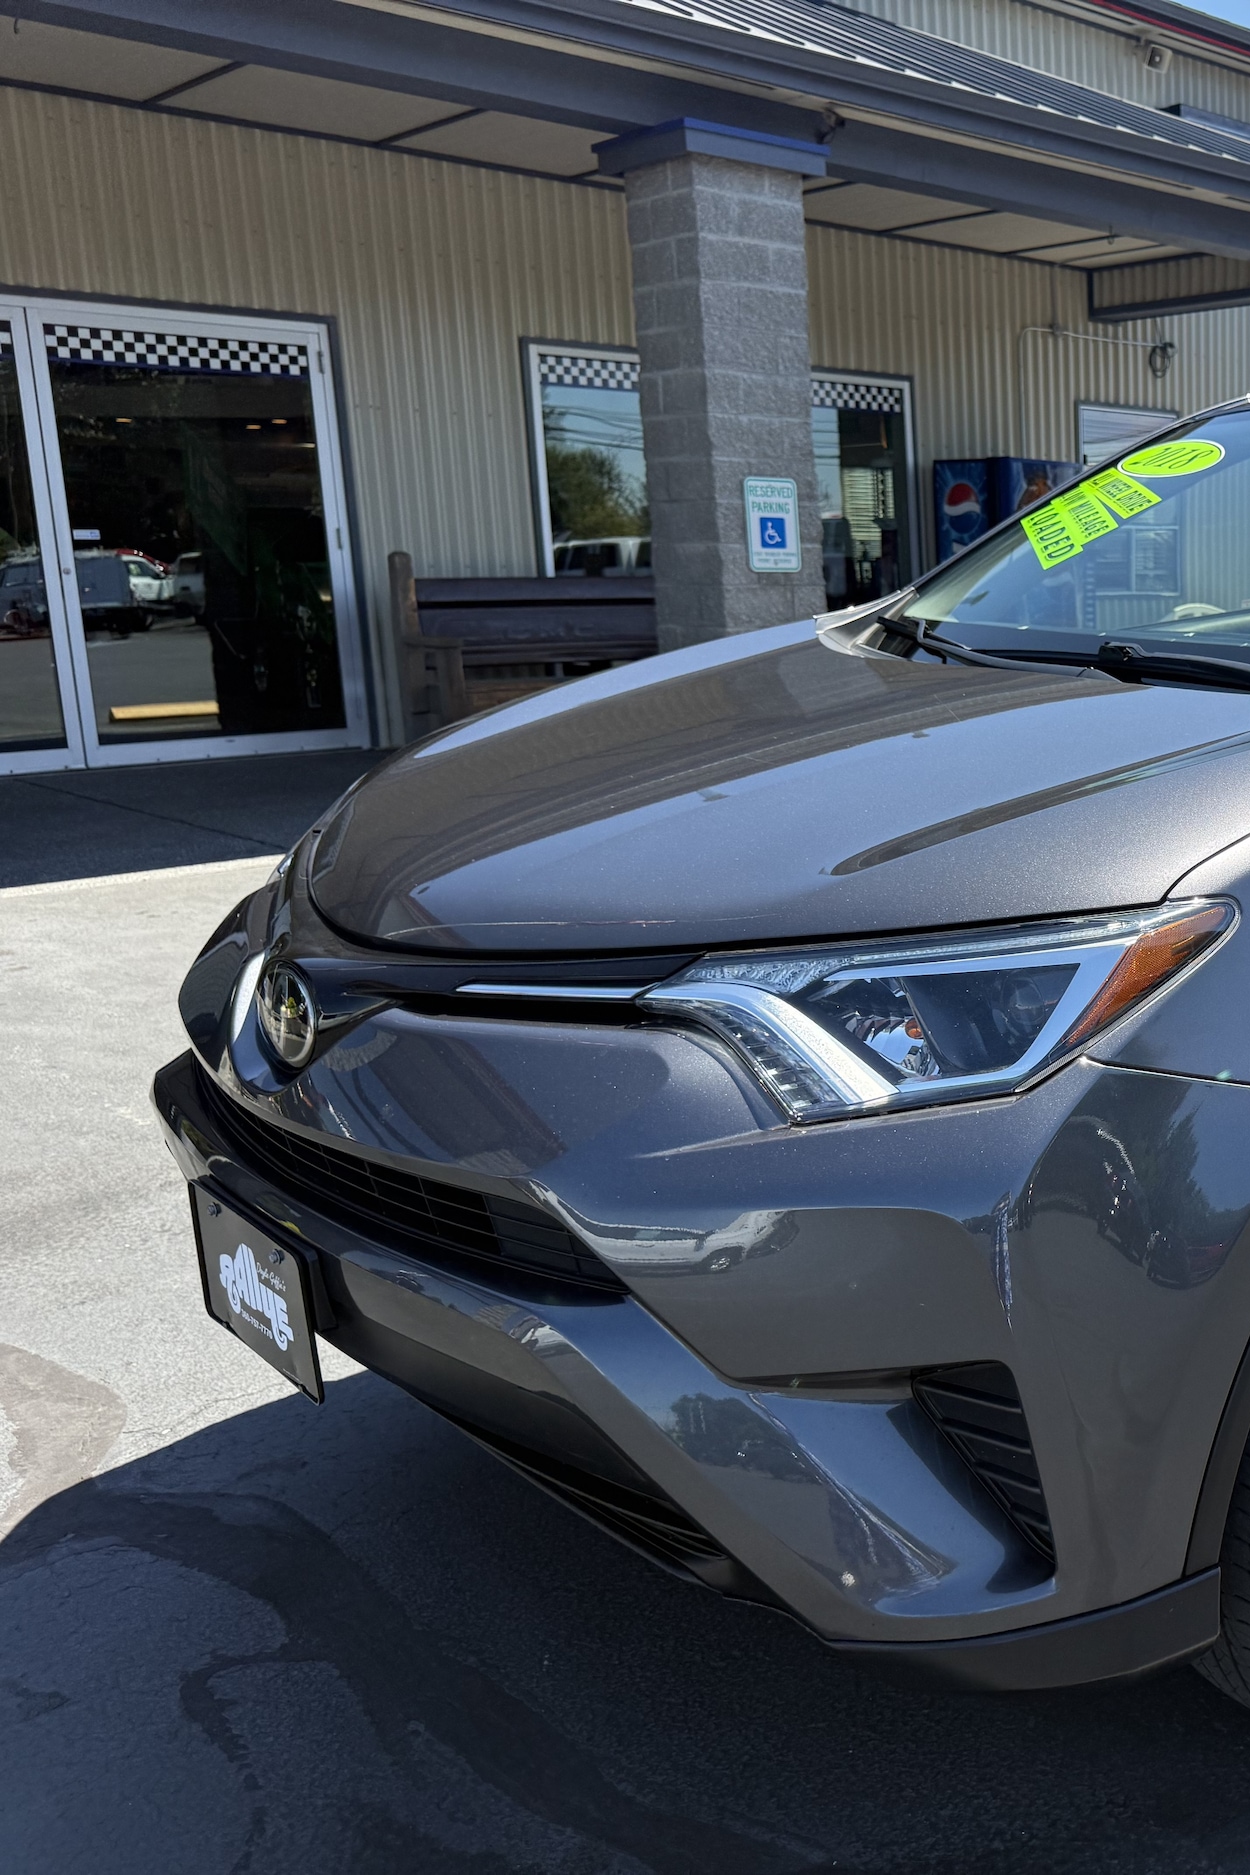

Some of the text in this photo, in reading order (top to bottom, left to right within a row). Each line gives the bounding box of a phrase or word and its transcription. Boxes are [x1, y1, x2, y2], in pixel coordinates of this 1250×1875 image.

[748, 485, 793, 499] RESERVED
[1116, 489, 1153, 513] DRIVE
[752, 501, 791, 515] PARKING
[1067, 500, 1110, 538] MILEAGE
[1028, 506, 1076, 560] LOADED
